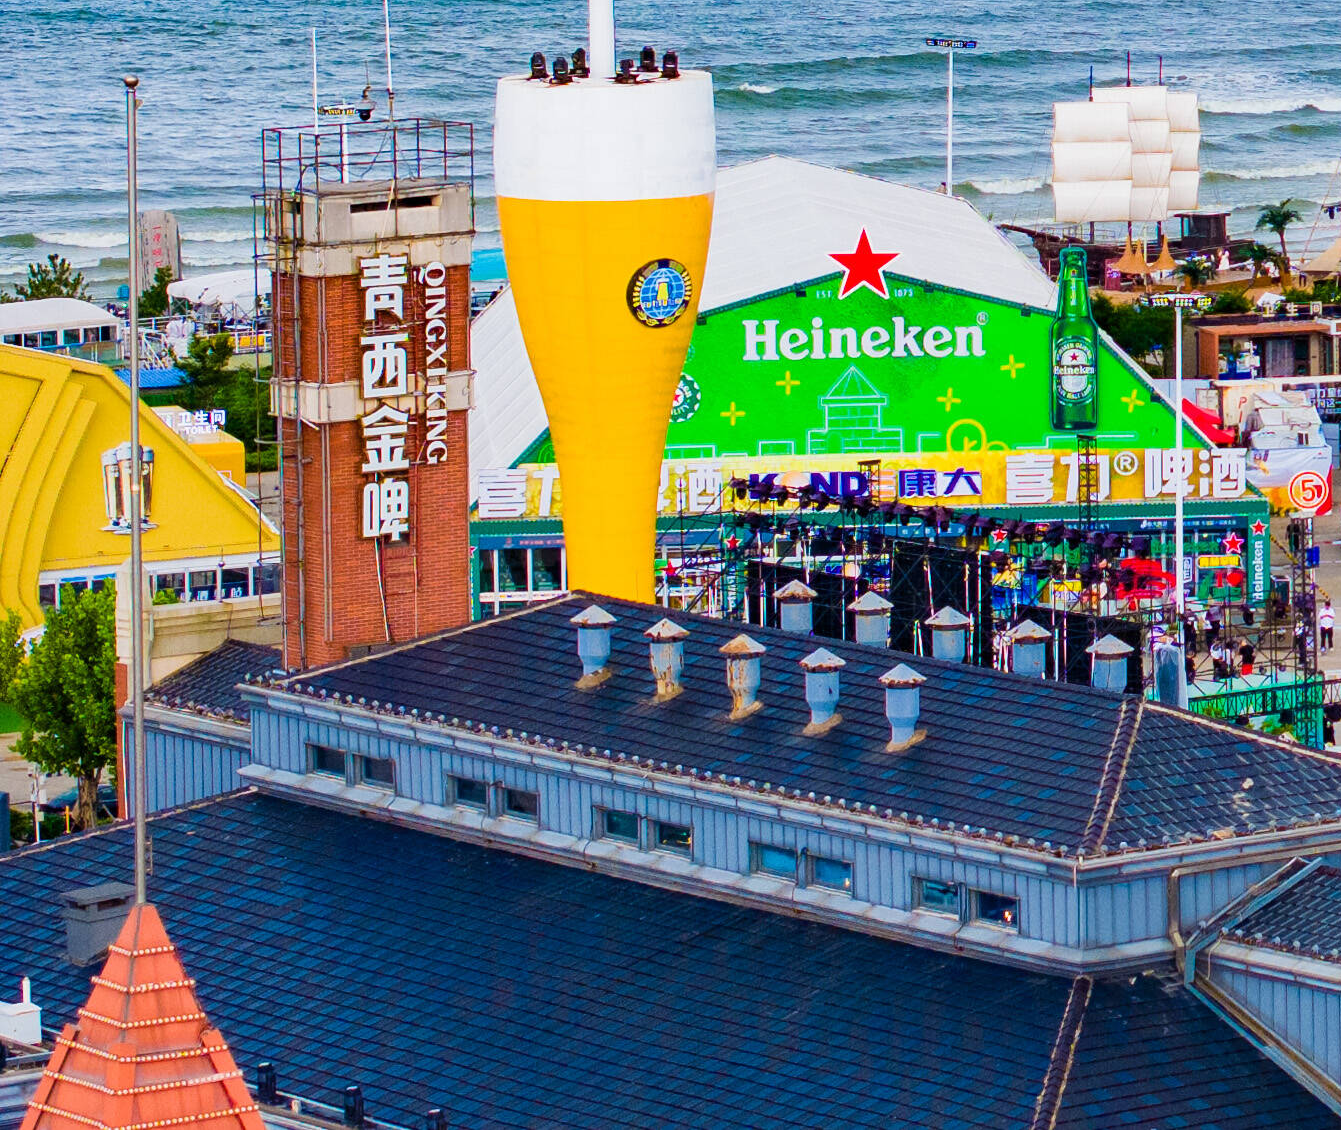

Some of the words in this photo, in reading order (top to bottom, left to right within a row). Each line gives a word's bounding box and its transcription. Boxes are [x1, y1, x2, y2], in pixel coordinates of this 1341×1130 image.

[359, 253, 411, 541] 青西金啤
[178, 410, 227, 426] 卫生间
[899, 467, 982, 497] 康大
[1300, 478, 1317, 503] 5
